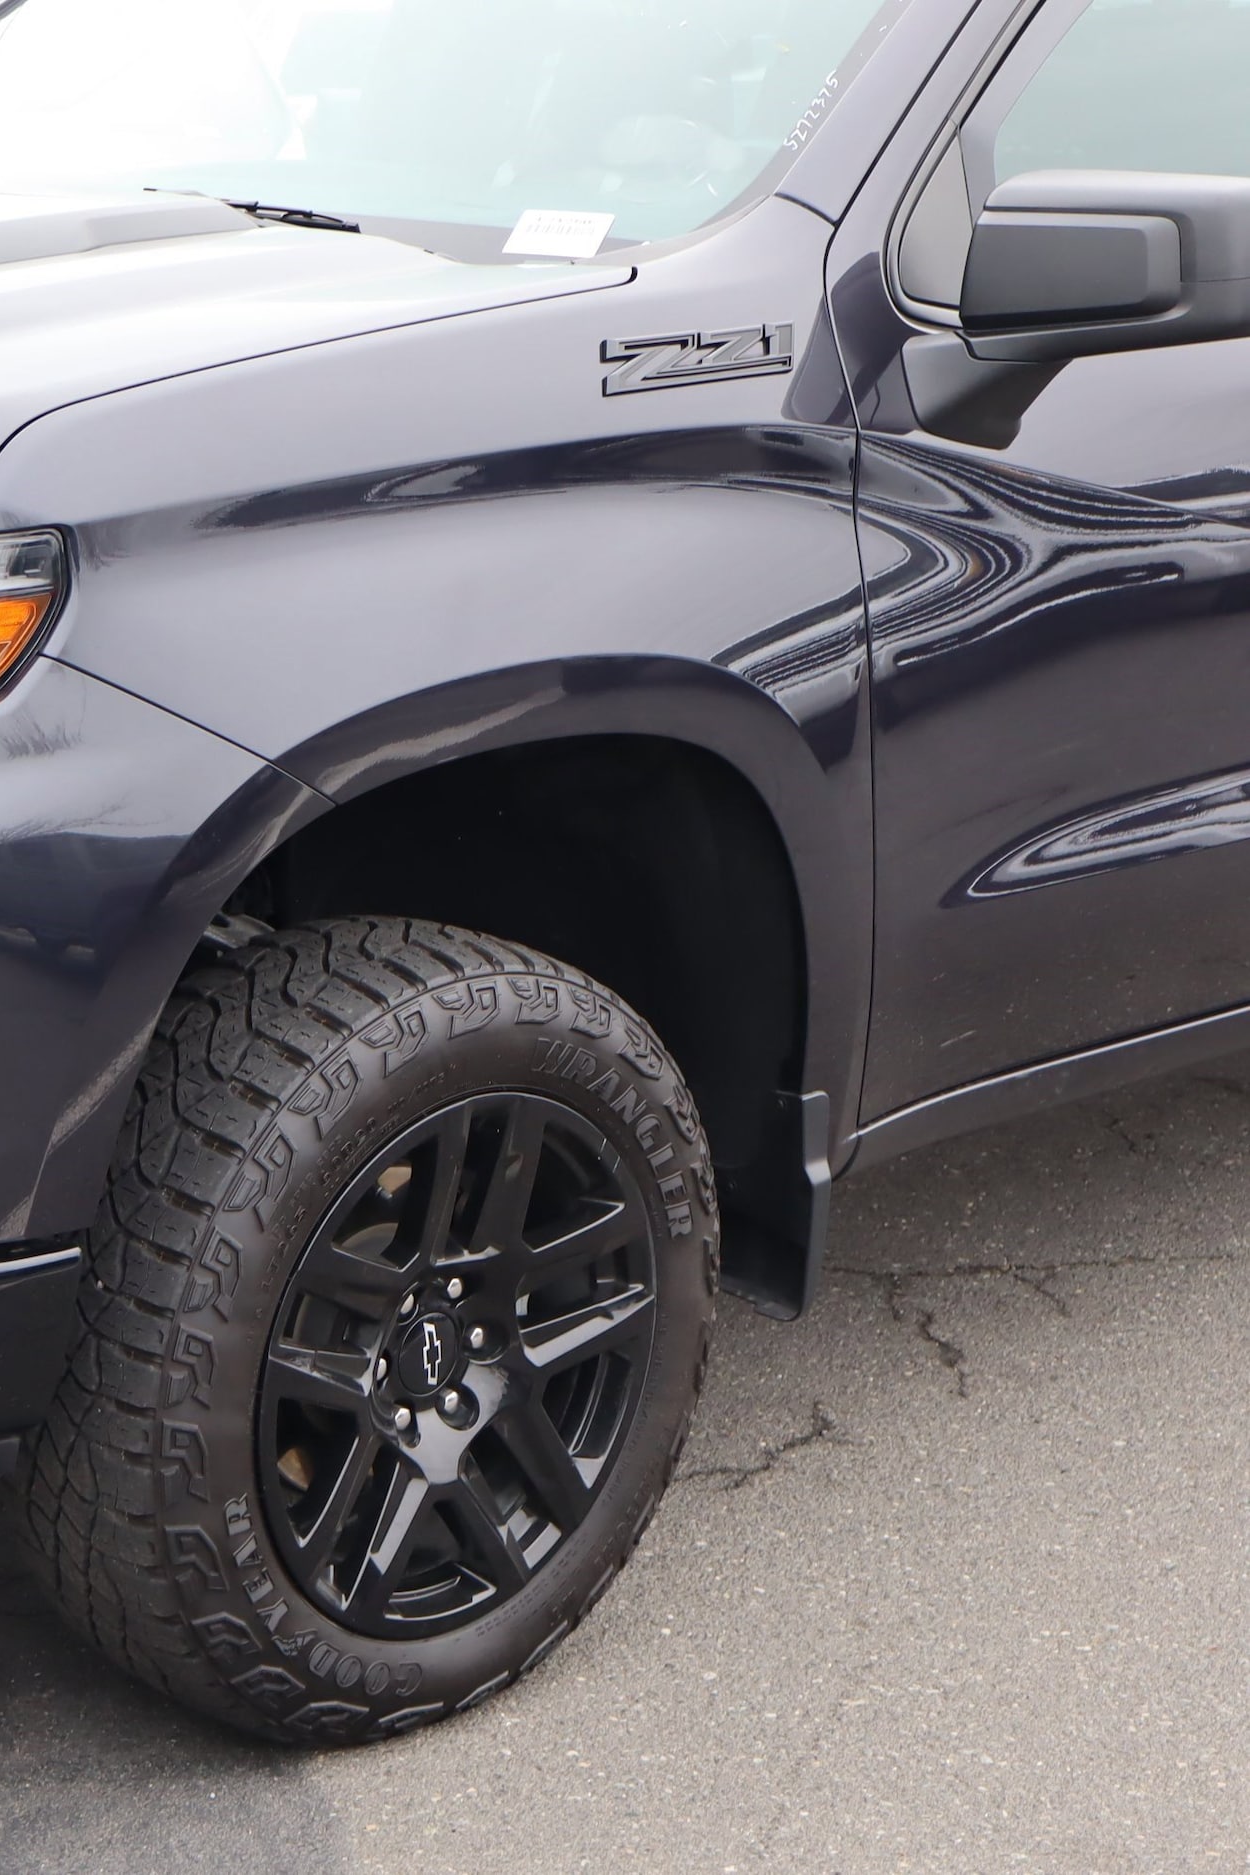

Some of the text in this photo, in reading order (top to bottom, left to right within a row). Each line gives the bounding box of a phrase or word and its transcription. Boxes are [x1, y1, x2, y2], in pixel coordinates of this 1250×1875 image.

[783, 69, 839, 151] 5272375
[600, 319, 794, 397] Z71
[531, 1037, 693, 1240] WRANGLER
[225, 1492, 423, 1697] GOODYEAR
